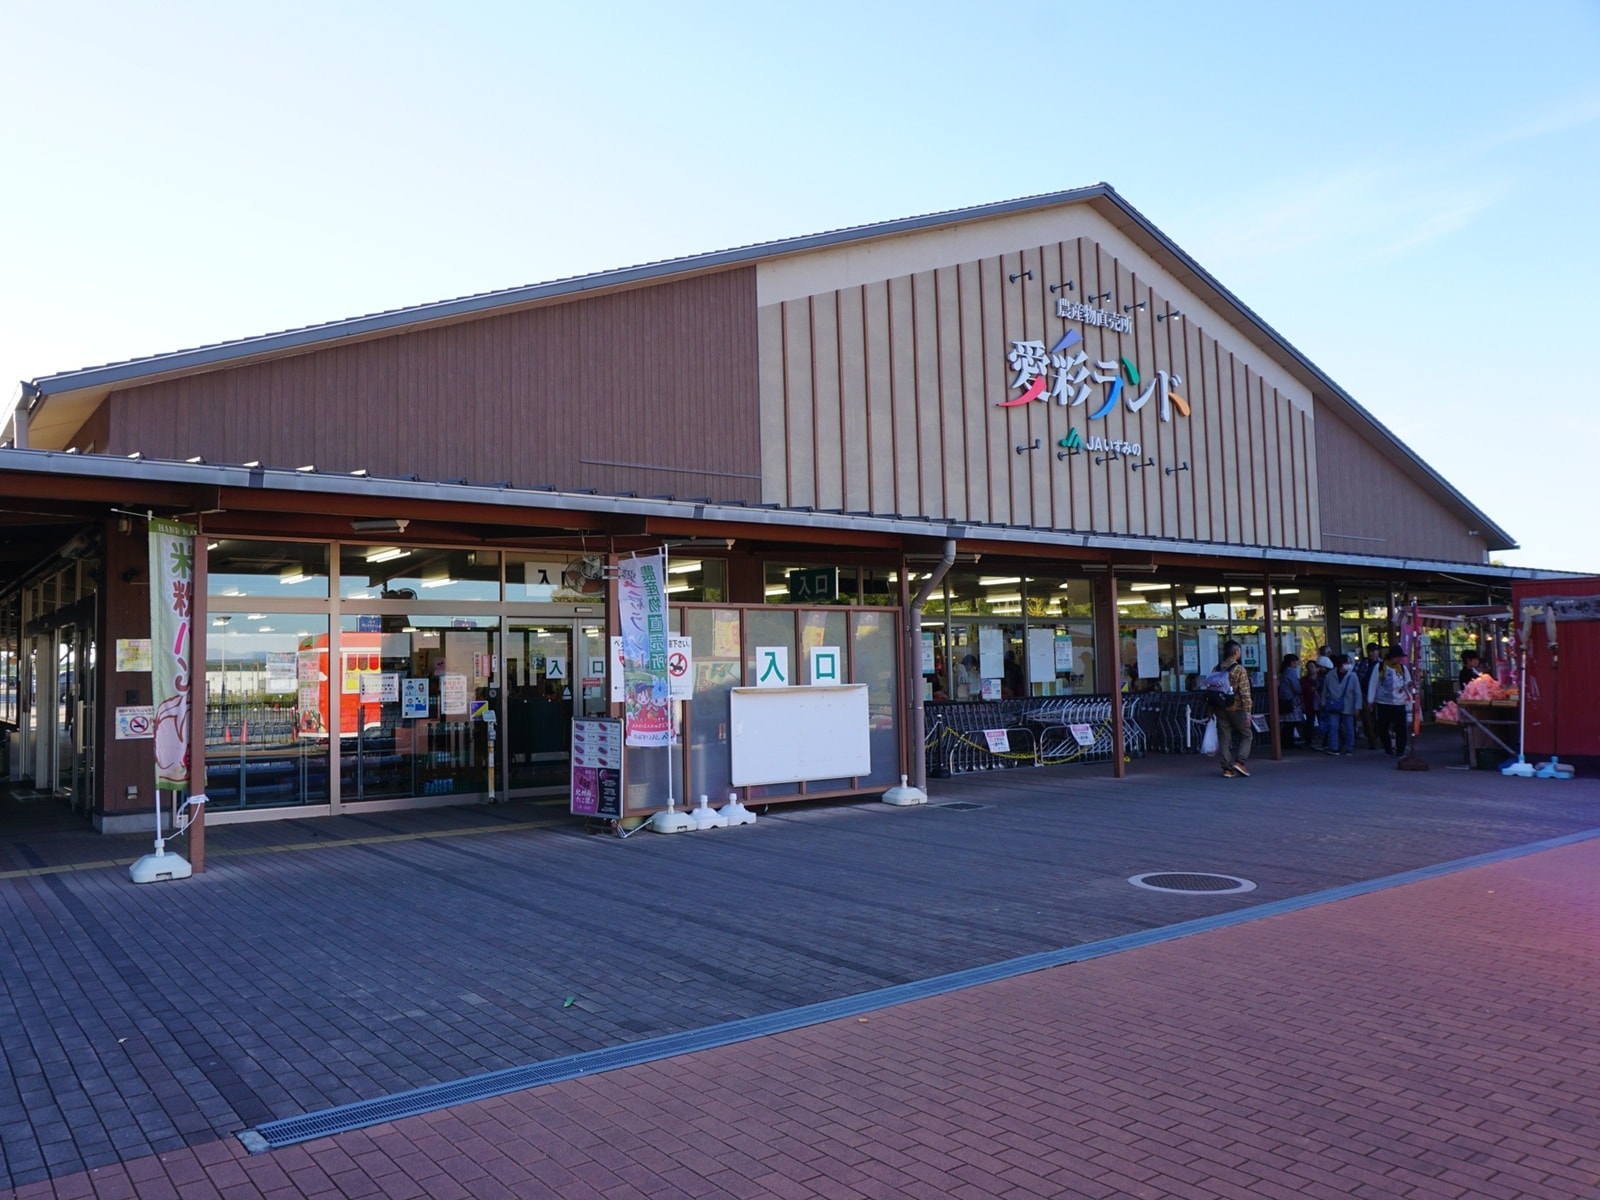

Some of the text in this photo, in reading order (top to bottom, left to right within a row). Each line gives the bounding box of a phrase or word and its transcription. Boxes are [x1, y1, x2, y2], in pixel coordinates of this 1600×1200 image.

[1056, 298, 1132, 335] 農産物直売所
[996, 329, 1190, 422] 愛彩ランド
[158, 524, 180, 535] HAND
[799, 575, 828, 595] 入口
